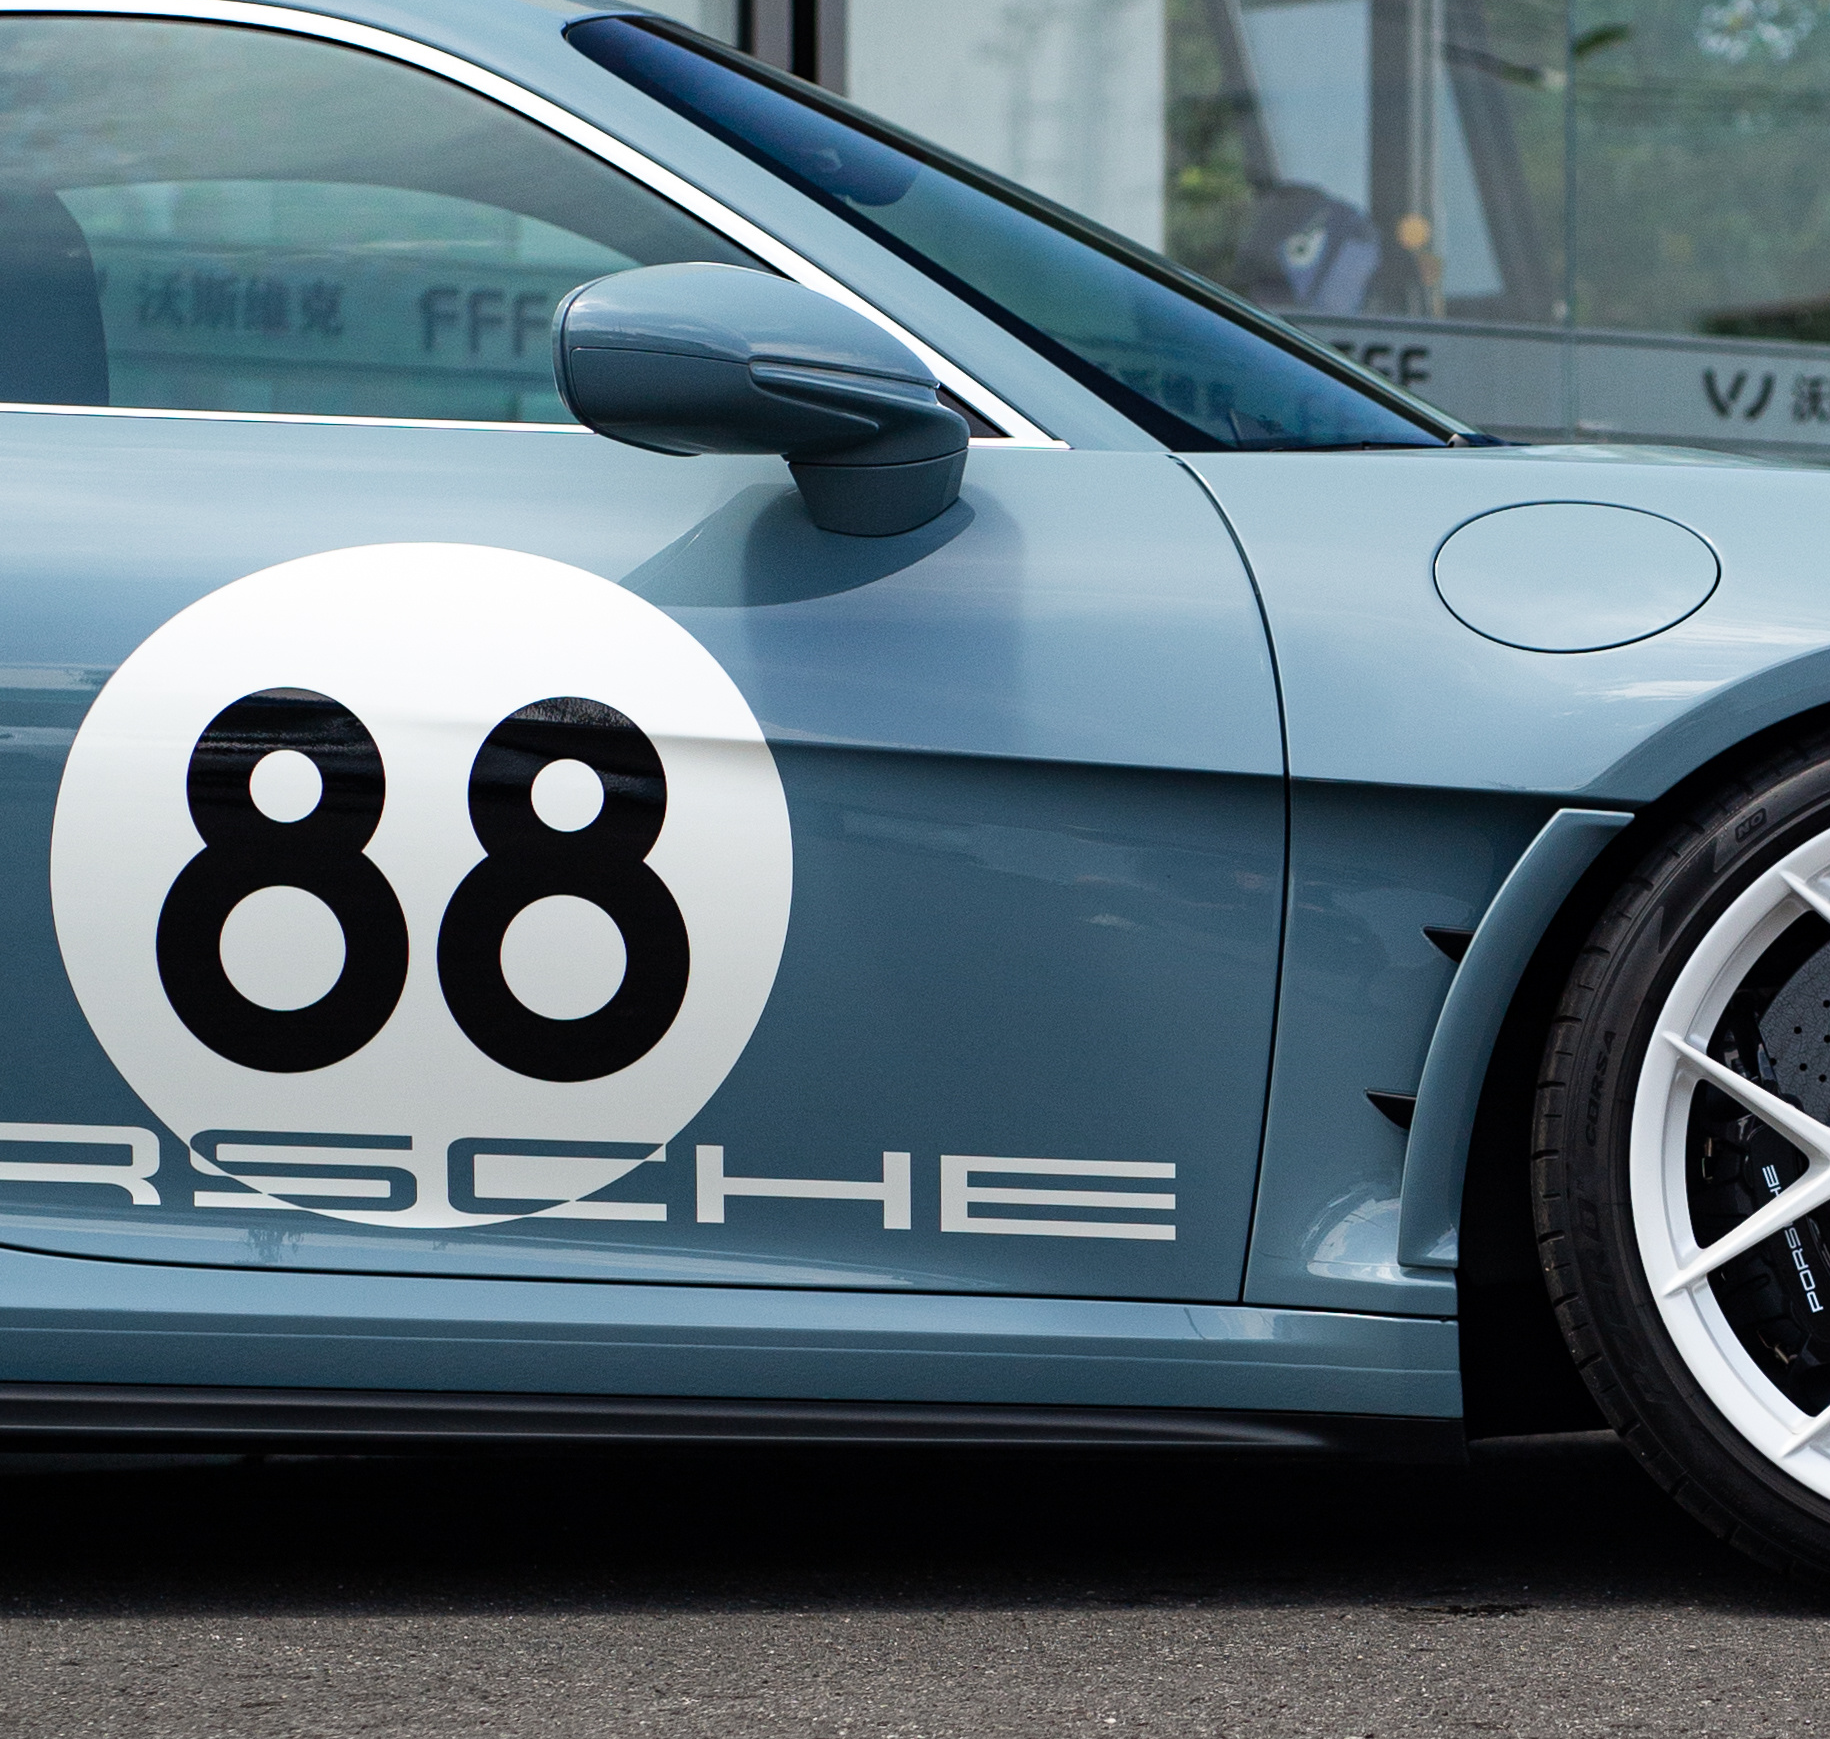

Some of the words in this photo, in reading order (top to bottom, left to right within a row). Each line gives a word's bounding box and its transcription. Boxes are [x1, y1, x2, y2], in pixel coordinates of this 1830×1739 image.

[418, 284, 549, 358] FFF
[156, 686, 691, 1082] 88
[1584, 1029, 1616, 1146] CORSA
